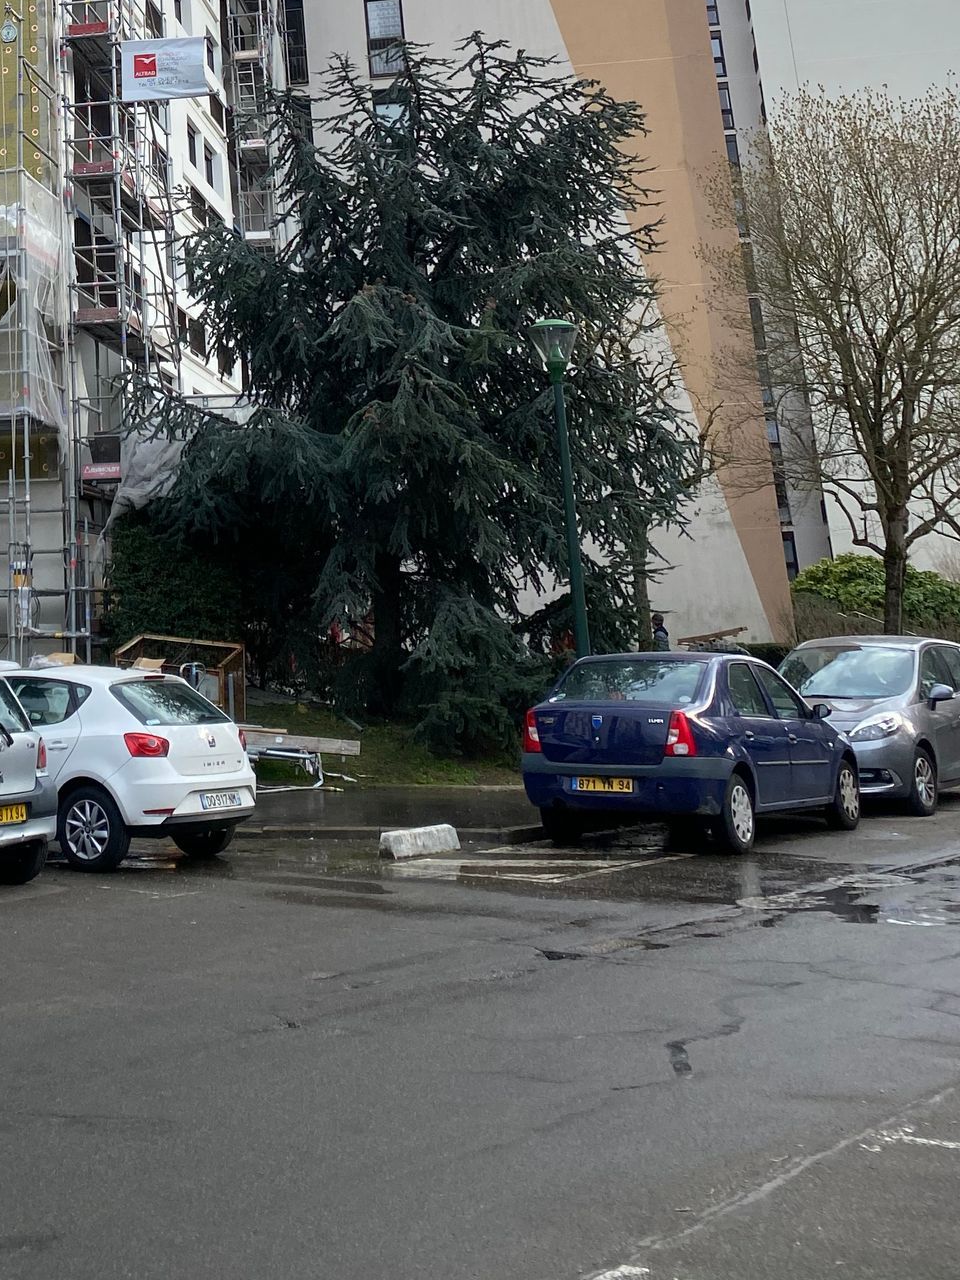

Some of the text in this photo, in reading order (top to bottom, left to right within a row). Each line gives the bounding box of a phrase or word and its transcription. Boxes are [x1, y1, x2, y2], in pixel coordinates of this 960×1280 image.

[578, 778, 596, 790] 871
[618, 780, 631, 791] 94
[15, 805, 24, 820] 94
